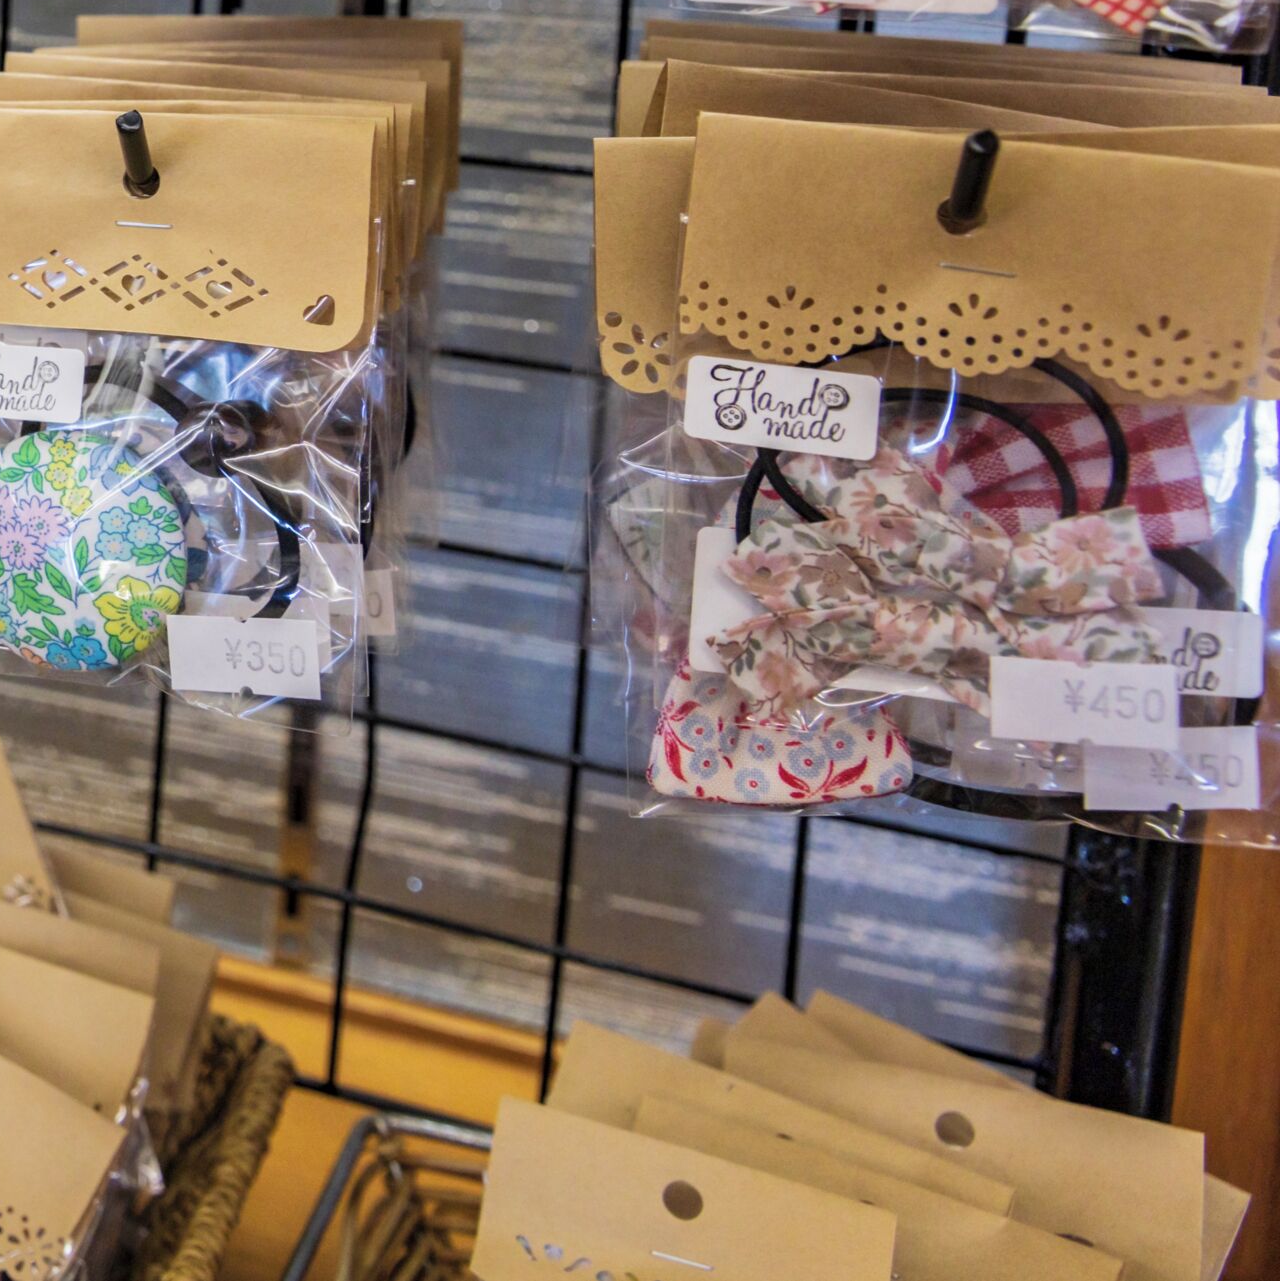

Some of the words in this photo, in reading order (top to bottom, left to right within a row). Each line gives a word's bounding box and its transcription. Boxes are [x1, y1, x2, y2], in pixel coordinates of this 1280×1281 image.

[710, 363, 820, 419] Hand
[762, 408, 846, 442] made
[223, 637, 307, 678] ¥350
[1063, 678, 1166, 724] ¥450
